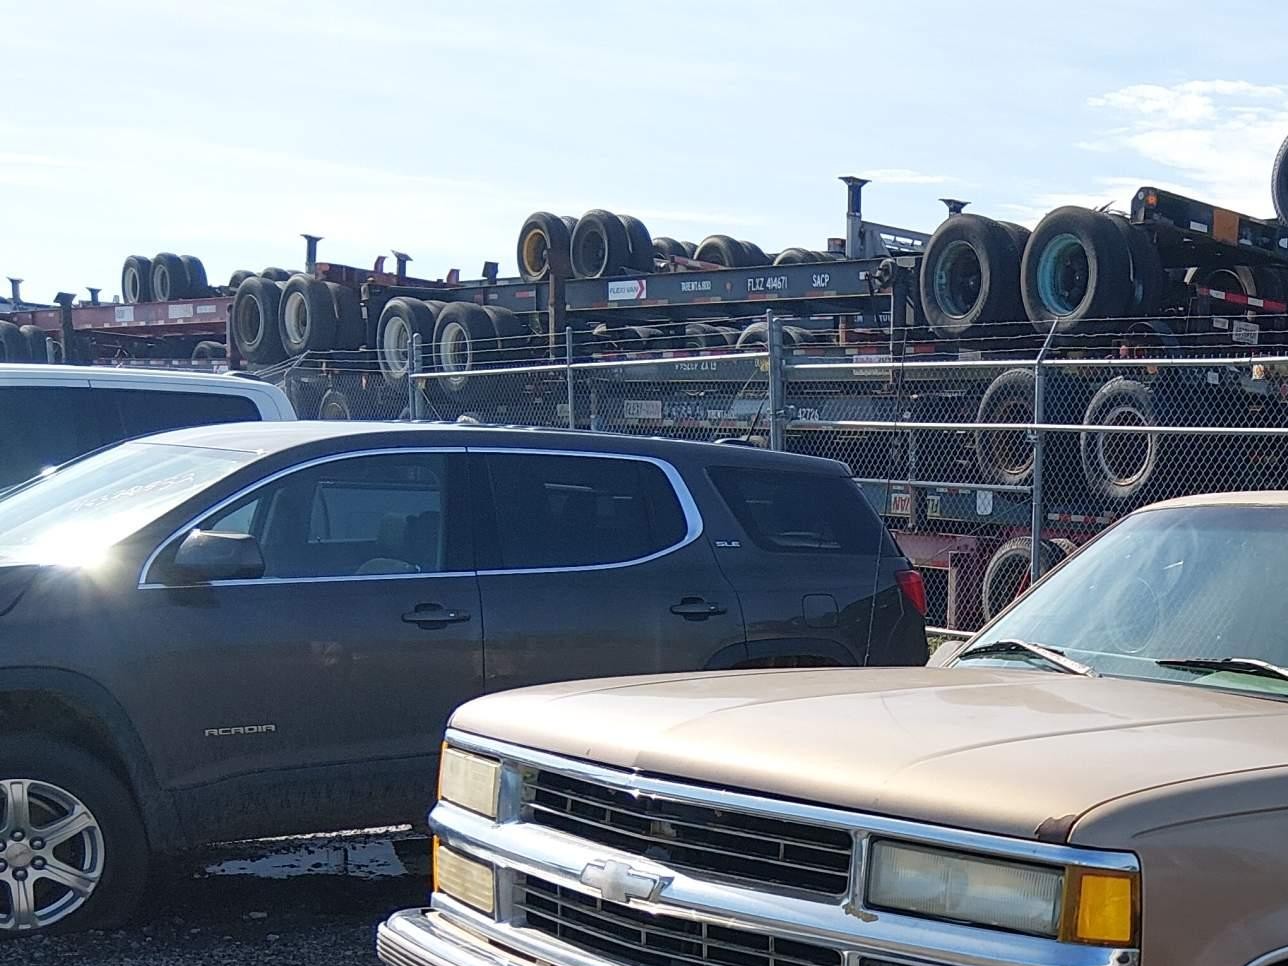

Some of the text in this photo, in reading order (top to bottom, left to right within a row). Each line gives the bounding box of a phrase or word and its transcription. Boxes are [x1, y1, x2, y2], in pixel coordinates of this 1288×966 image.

[747, 278, 765, 291] FLXZ
[812, 275, 830, 288] SACP
[205, 724, 275, 737] ACADIA
